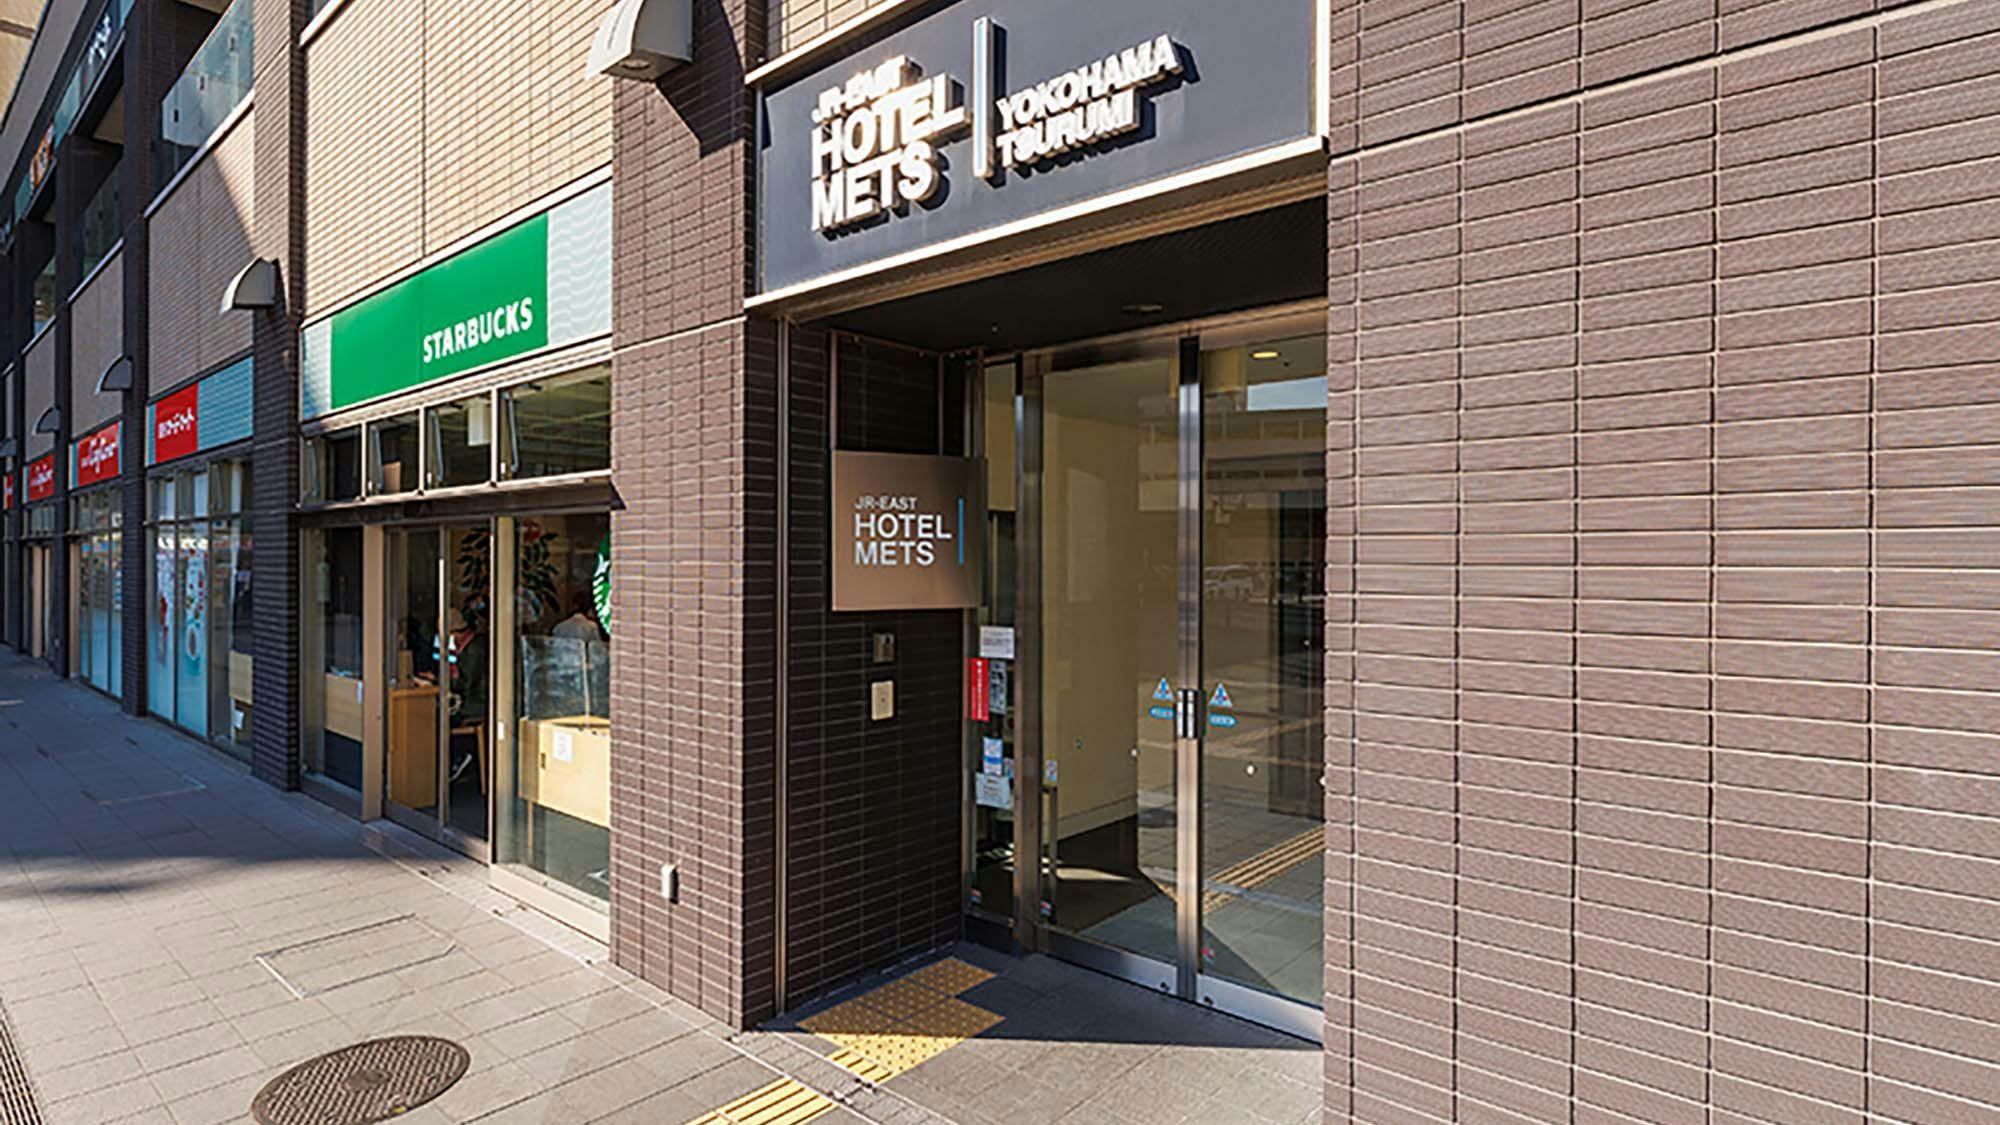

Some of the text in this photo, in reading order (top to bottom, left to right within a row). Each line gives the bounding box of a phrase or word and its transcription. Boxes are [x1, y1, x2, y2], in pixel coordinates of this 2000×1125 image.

[996, 33, 1178, 130] YOKOHAMA
[811, 73, 966, 178] HOTEL
[996, 88, 1136, 168] TSURUMI
[811, 138, 934, 231] METS
[423, 296, 533, 363] STARBUCKS
[854, 495, 918, 511] JR-EAST
[854, 513, 953, 540] HOTEL
[854, 540, 936, 567] METS
